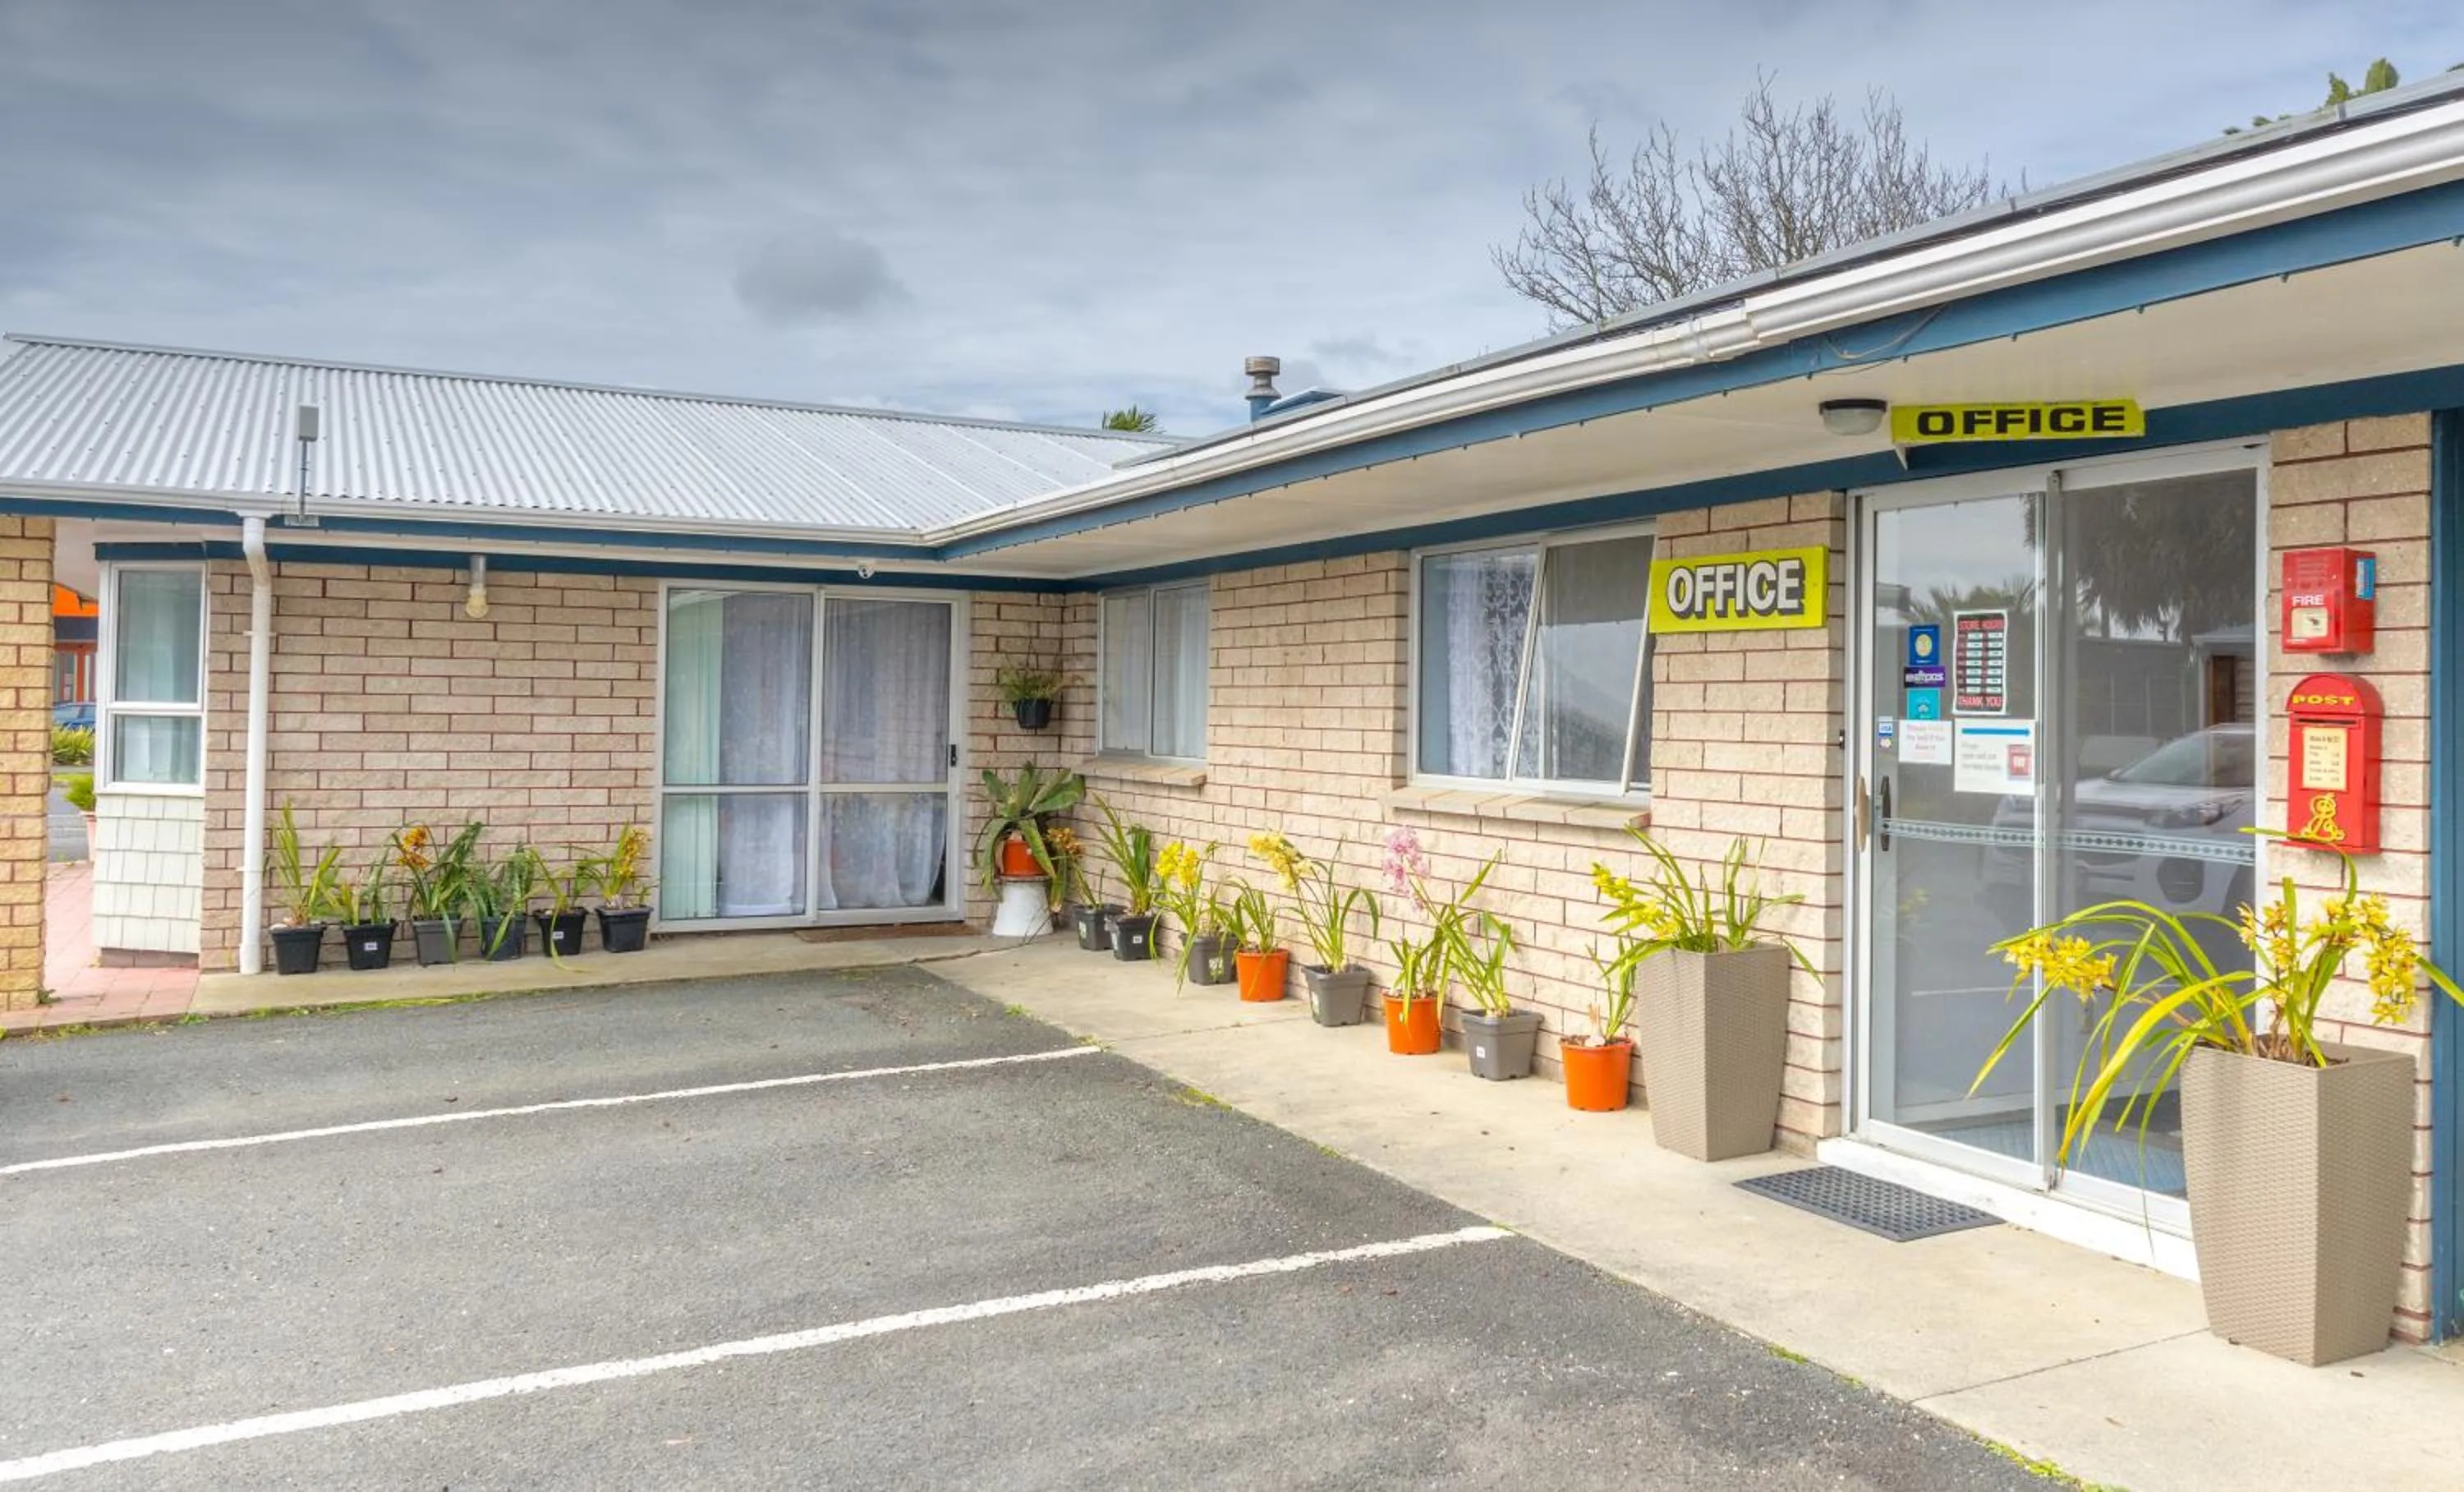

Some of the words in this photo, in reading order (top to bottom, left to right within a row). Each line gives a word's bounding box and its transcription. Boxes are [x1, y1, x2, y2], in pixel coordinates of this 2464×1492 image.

[1917, 405, 2126, 436] OFFICE
[1666, 559, 1804, 617] OFFICE
[2292, 594, 2324, 606] FIRE
[1986, 696, 2002, 707] YOU
[2292, 694, 2356, 706] POST
